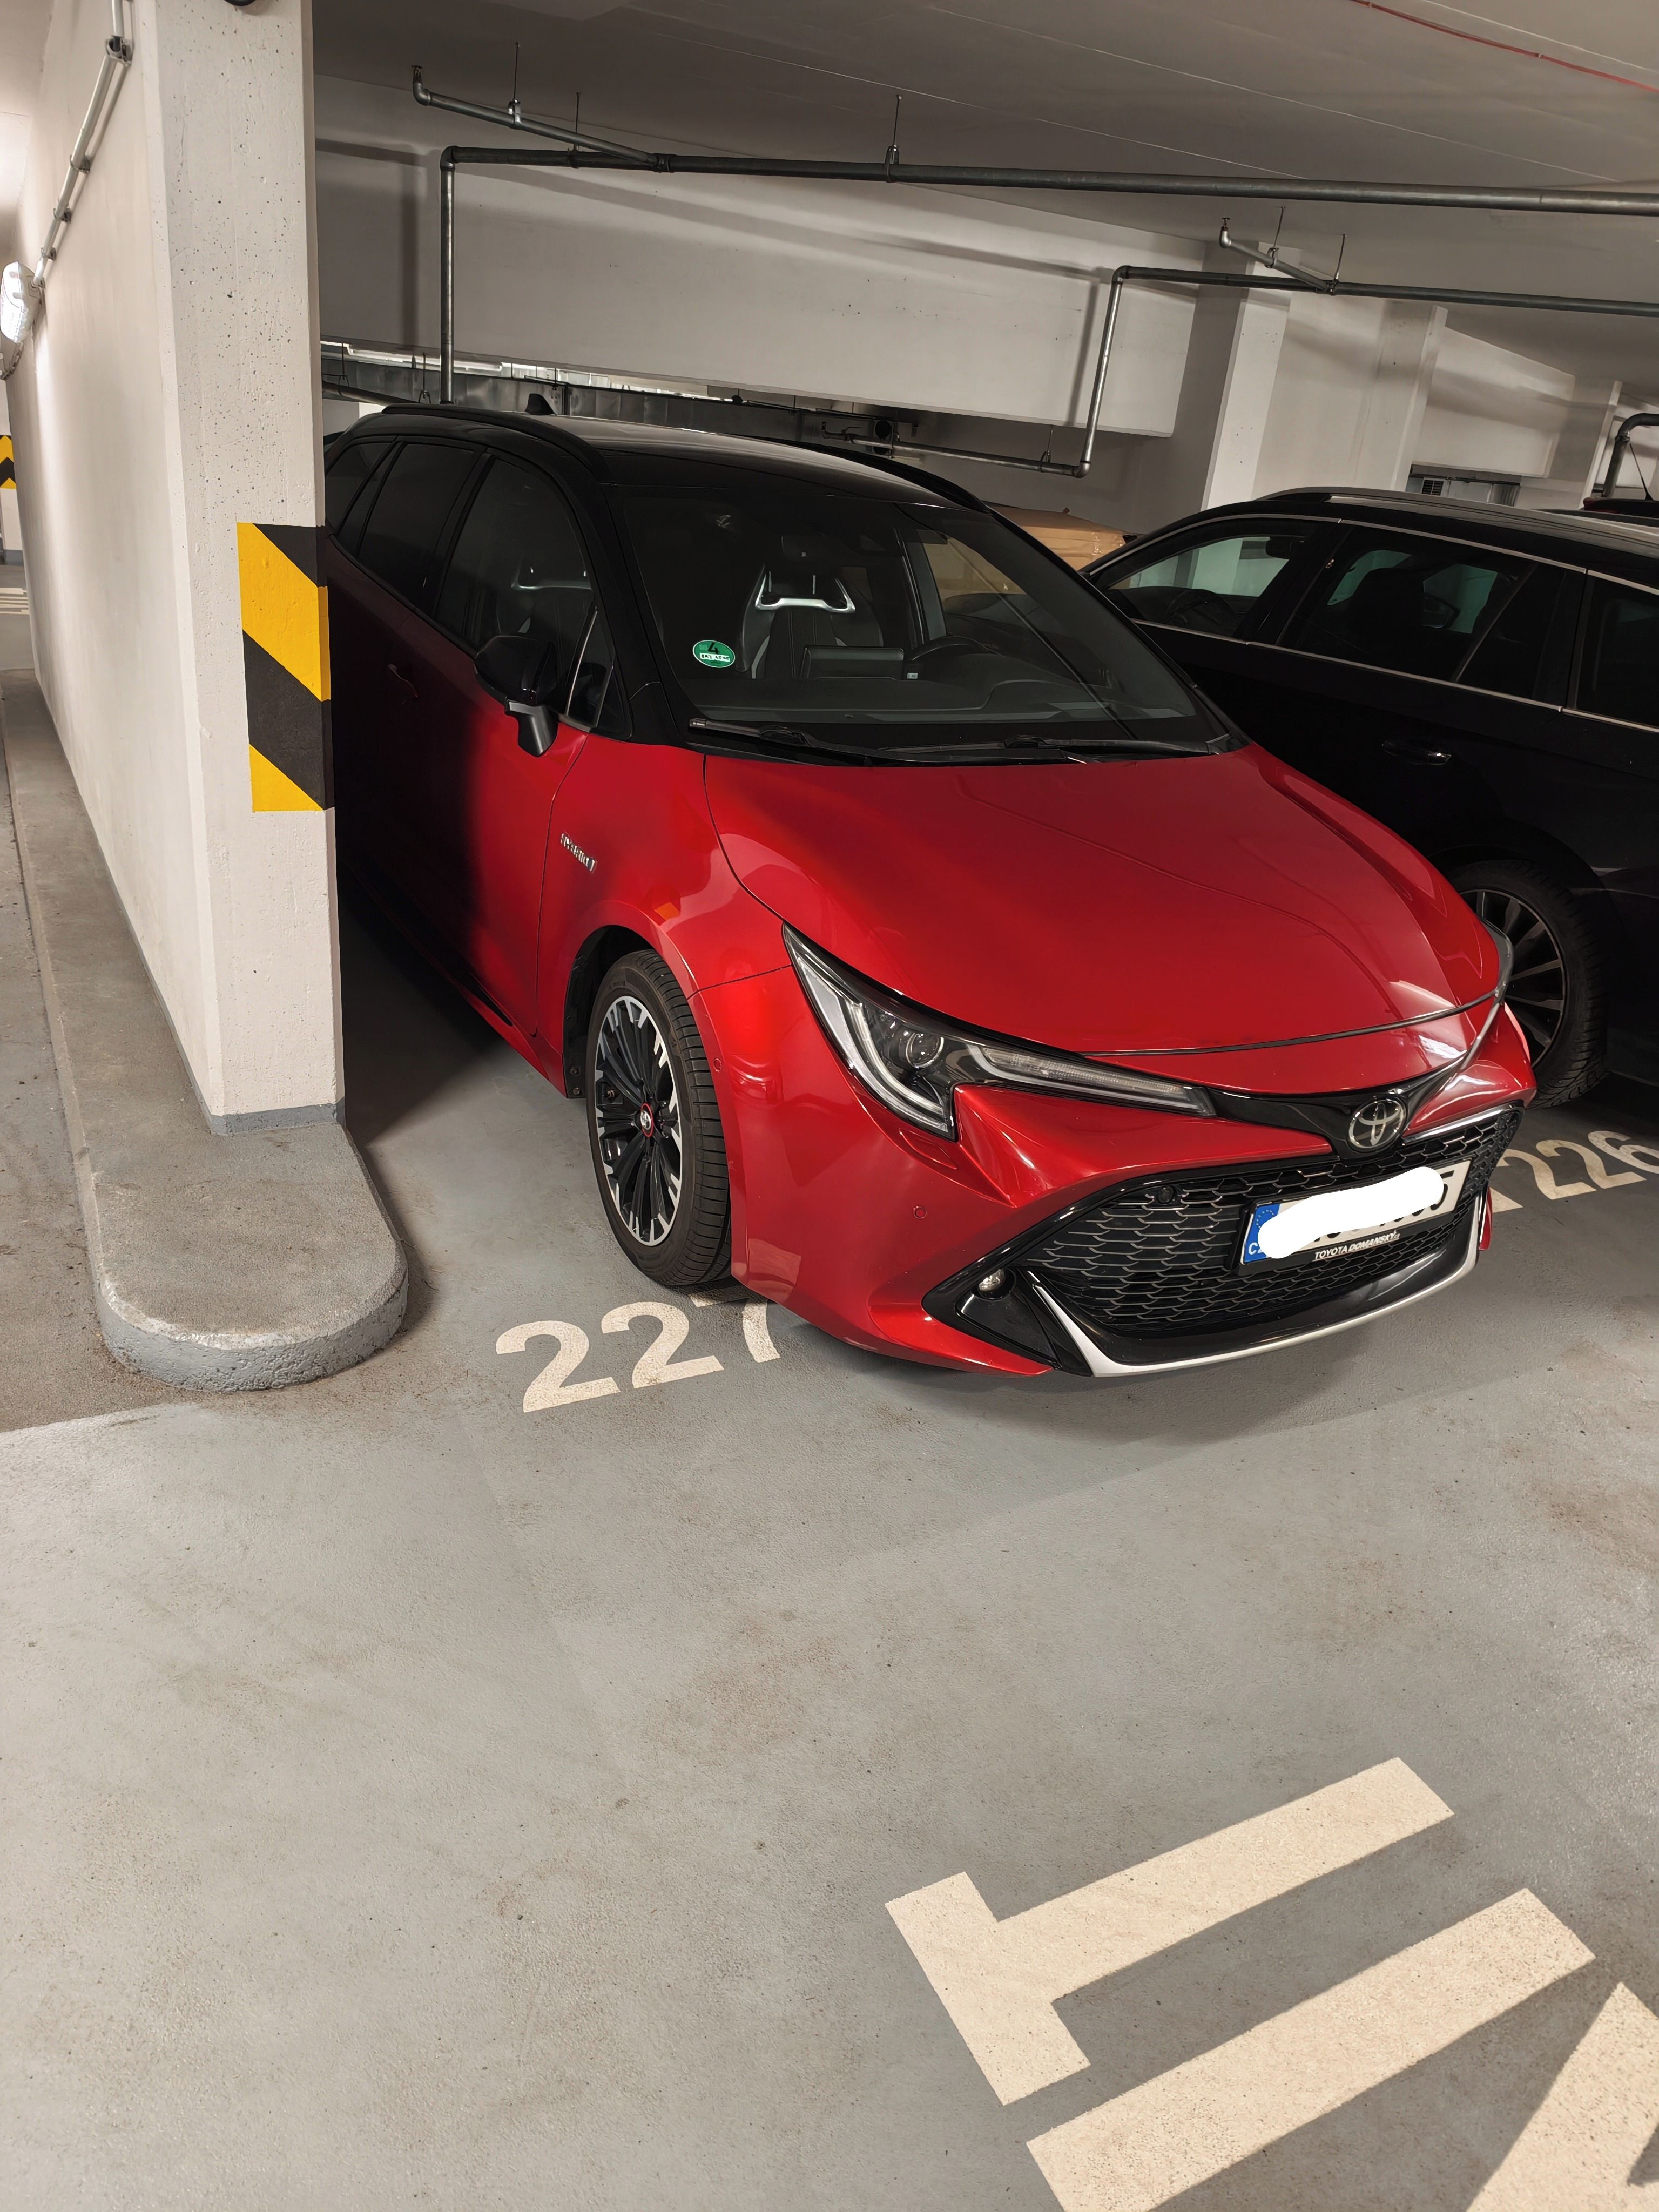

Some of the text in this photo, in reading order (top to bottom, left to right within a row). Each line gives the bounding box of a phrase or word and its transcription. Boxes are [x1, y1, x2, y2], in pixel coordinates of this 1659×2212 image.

[708, 641, 720, 654] 4
[1496, 1130, 1659, 1201] 226
[1314, 1245, 1347, 1260] TOYOTA
